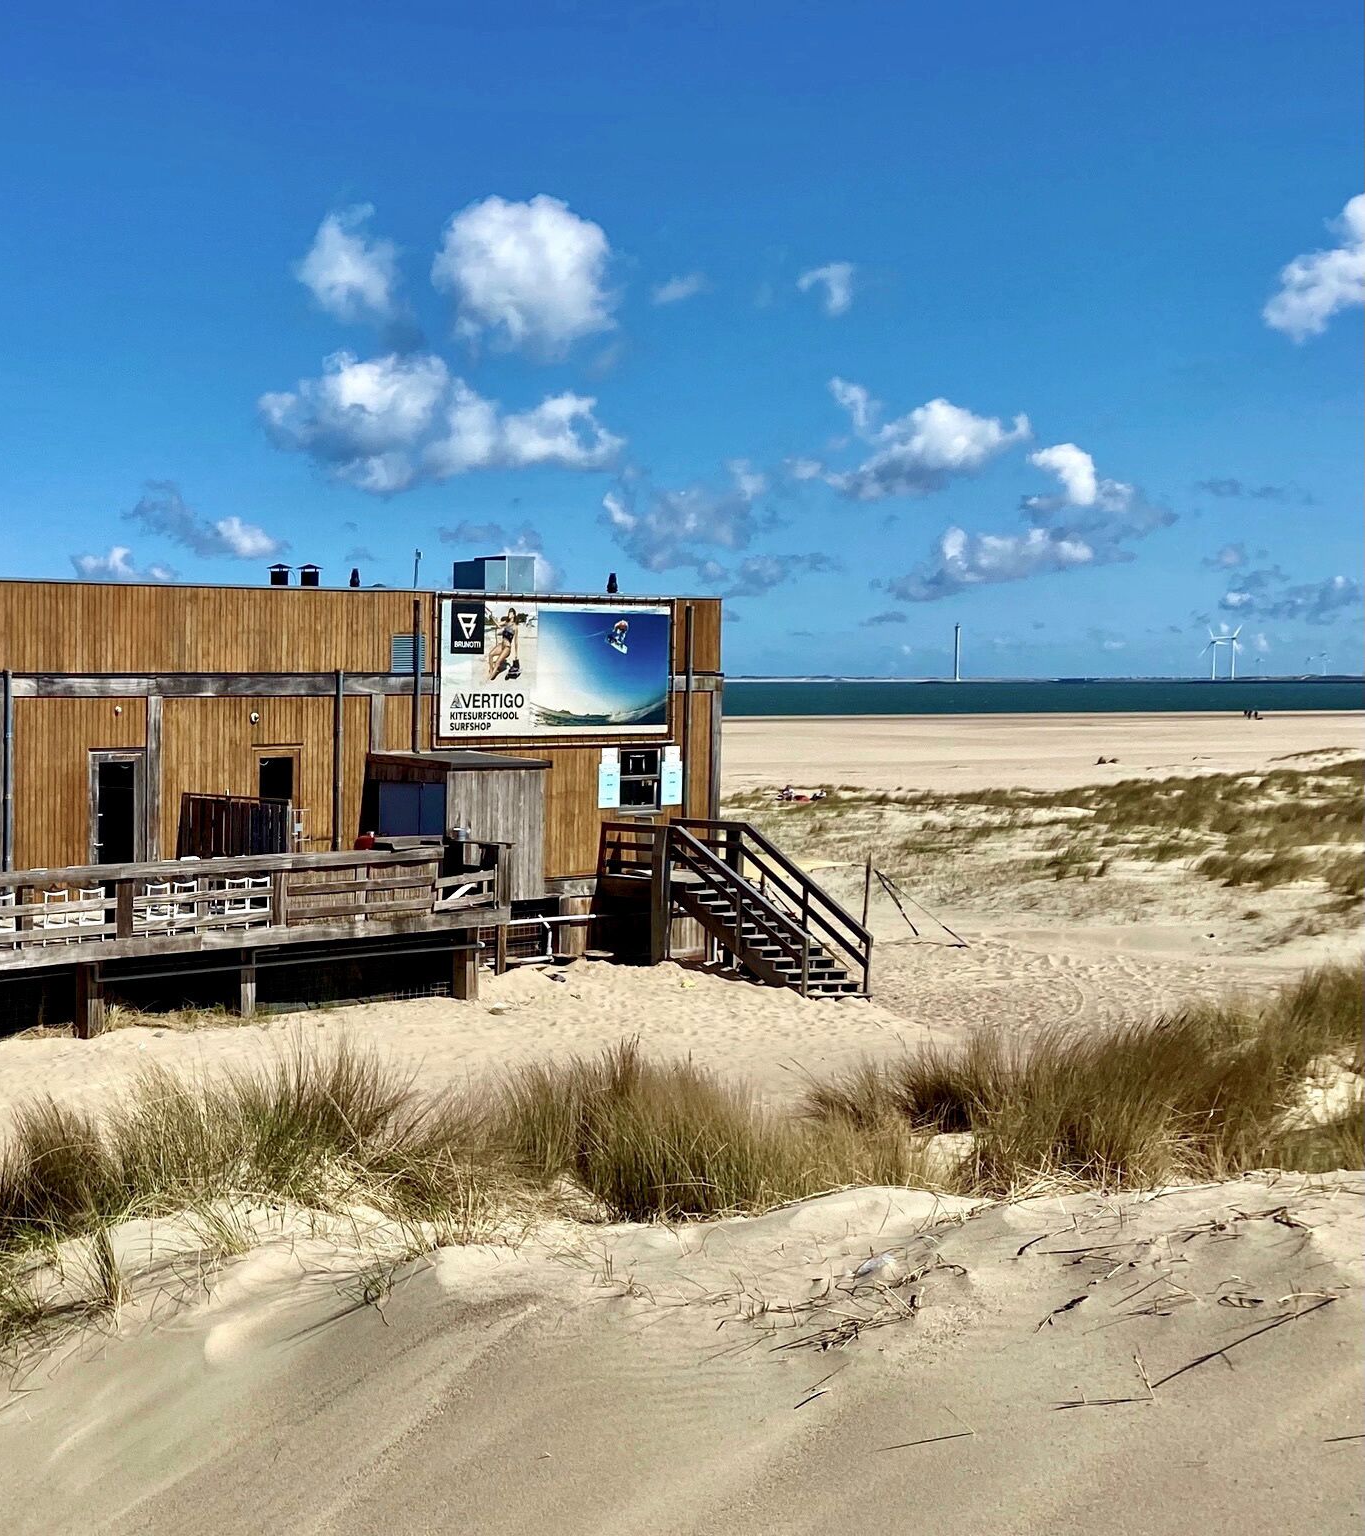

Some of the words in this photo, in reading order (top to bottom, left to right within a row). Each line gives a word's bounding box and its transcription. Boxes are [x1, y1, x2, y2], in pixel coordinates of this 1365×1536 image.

[454, 640, 481, 648] BRUNOTTI
[460, 693, 524, 709] VERTIGO
[450, 711, 519, 720] KITESURFSCHOOL
[449, 722, 492, 731] SURFSHOP
